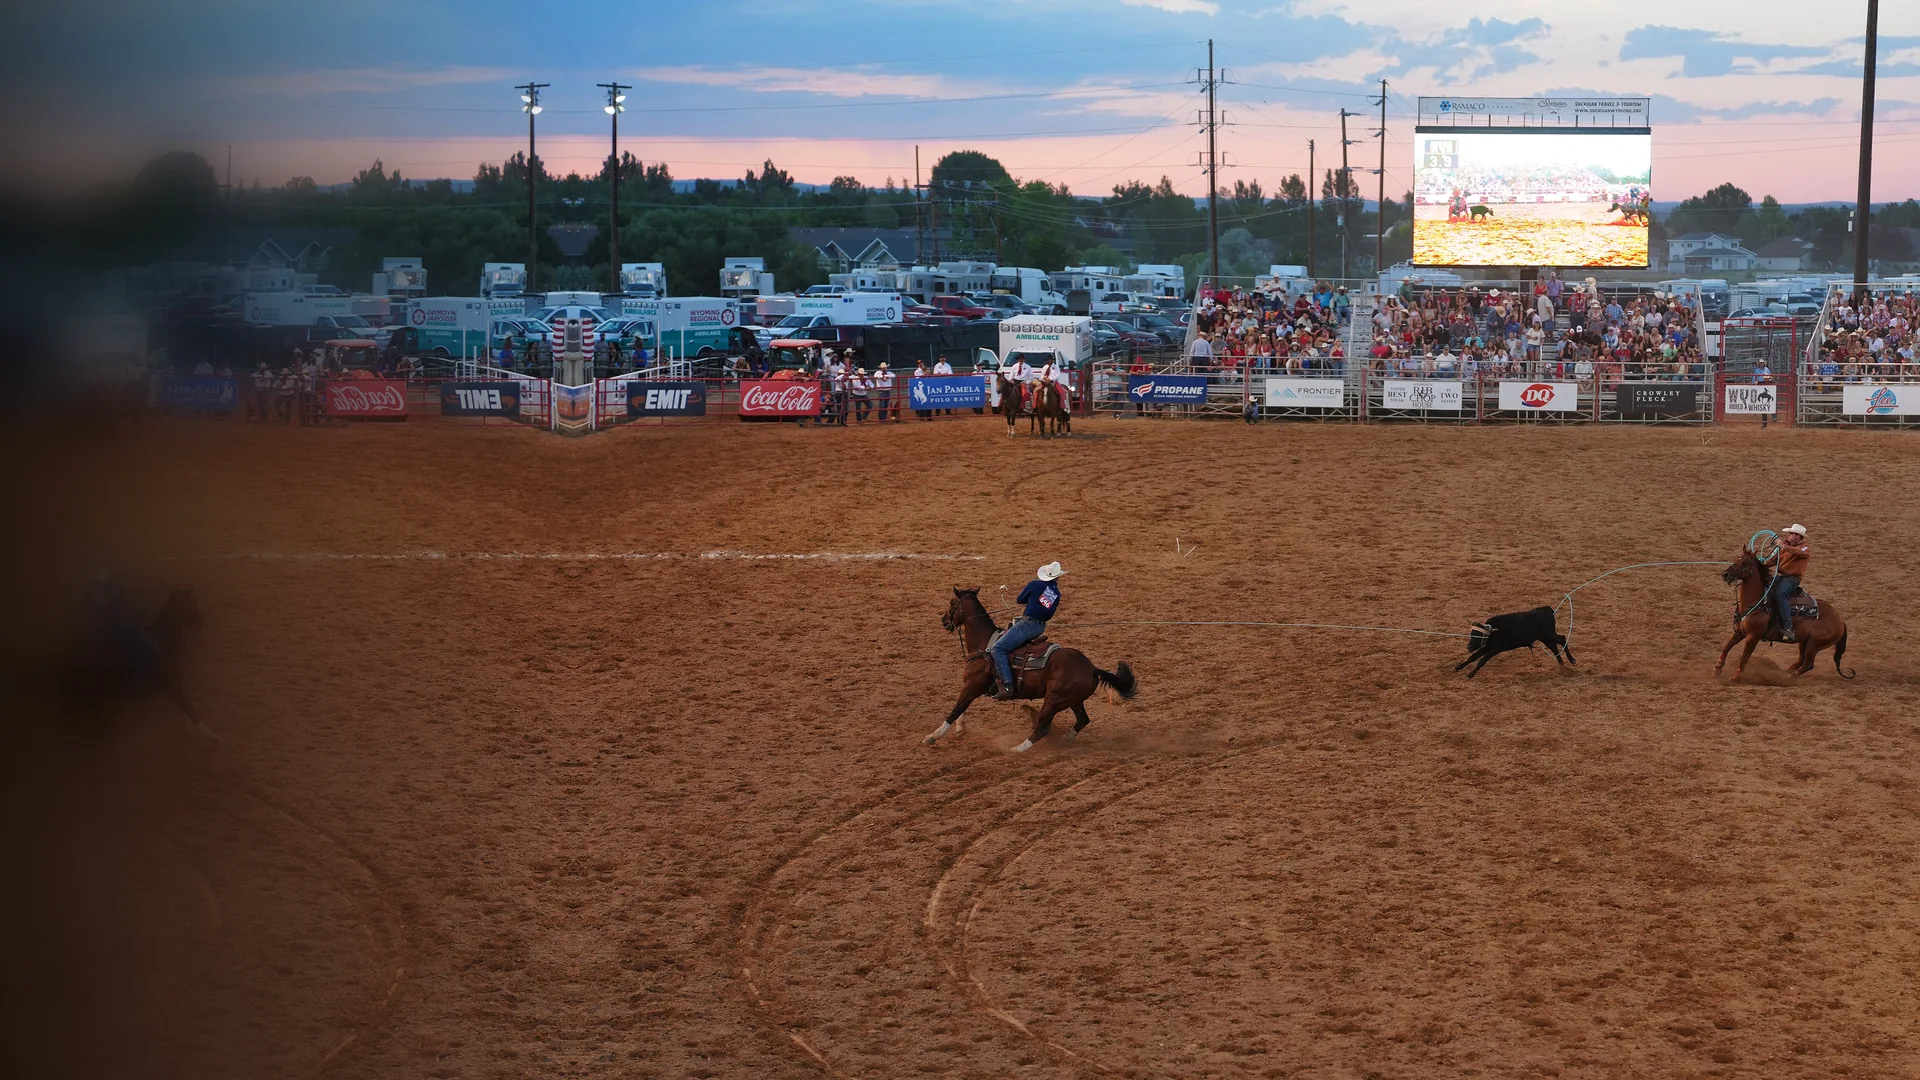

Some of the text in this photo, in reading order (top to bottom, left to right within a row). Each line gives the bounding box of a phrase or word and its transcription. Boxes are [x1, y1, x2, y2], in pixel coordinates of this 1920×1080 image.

[1430, 155, 1452, 168] 3.9
[927, 386, 942, 395] JAN
[1154, 386, 1204, 394] PROPANE
[1526, 389, 1550, 402] DQ
[645, 390, 692, 409] EMIT
[742, 386, 818, 411] Coca-Cola
[1410, 394, 1436, 402] CHOP
[1728, 388, 1757, 409] WYO
[1865, 387, 1899, 413] Lee
